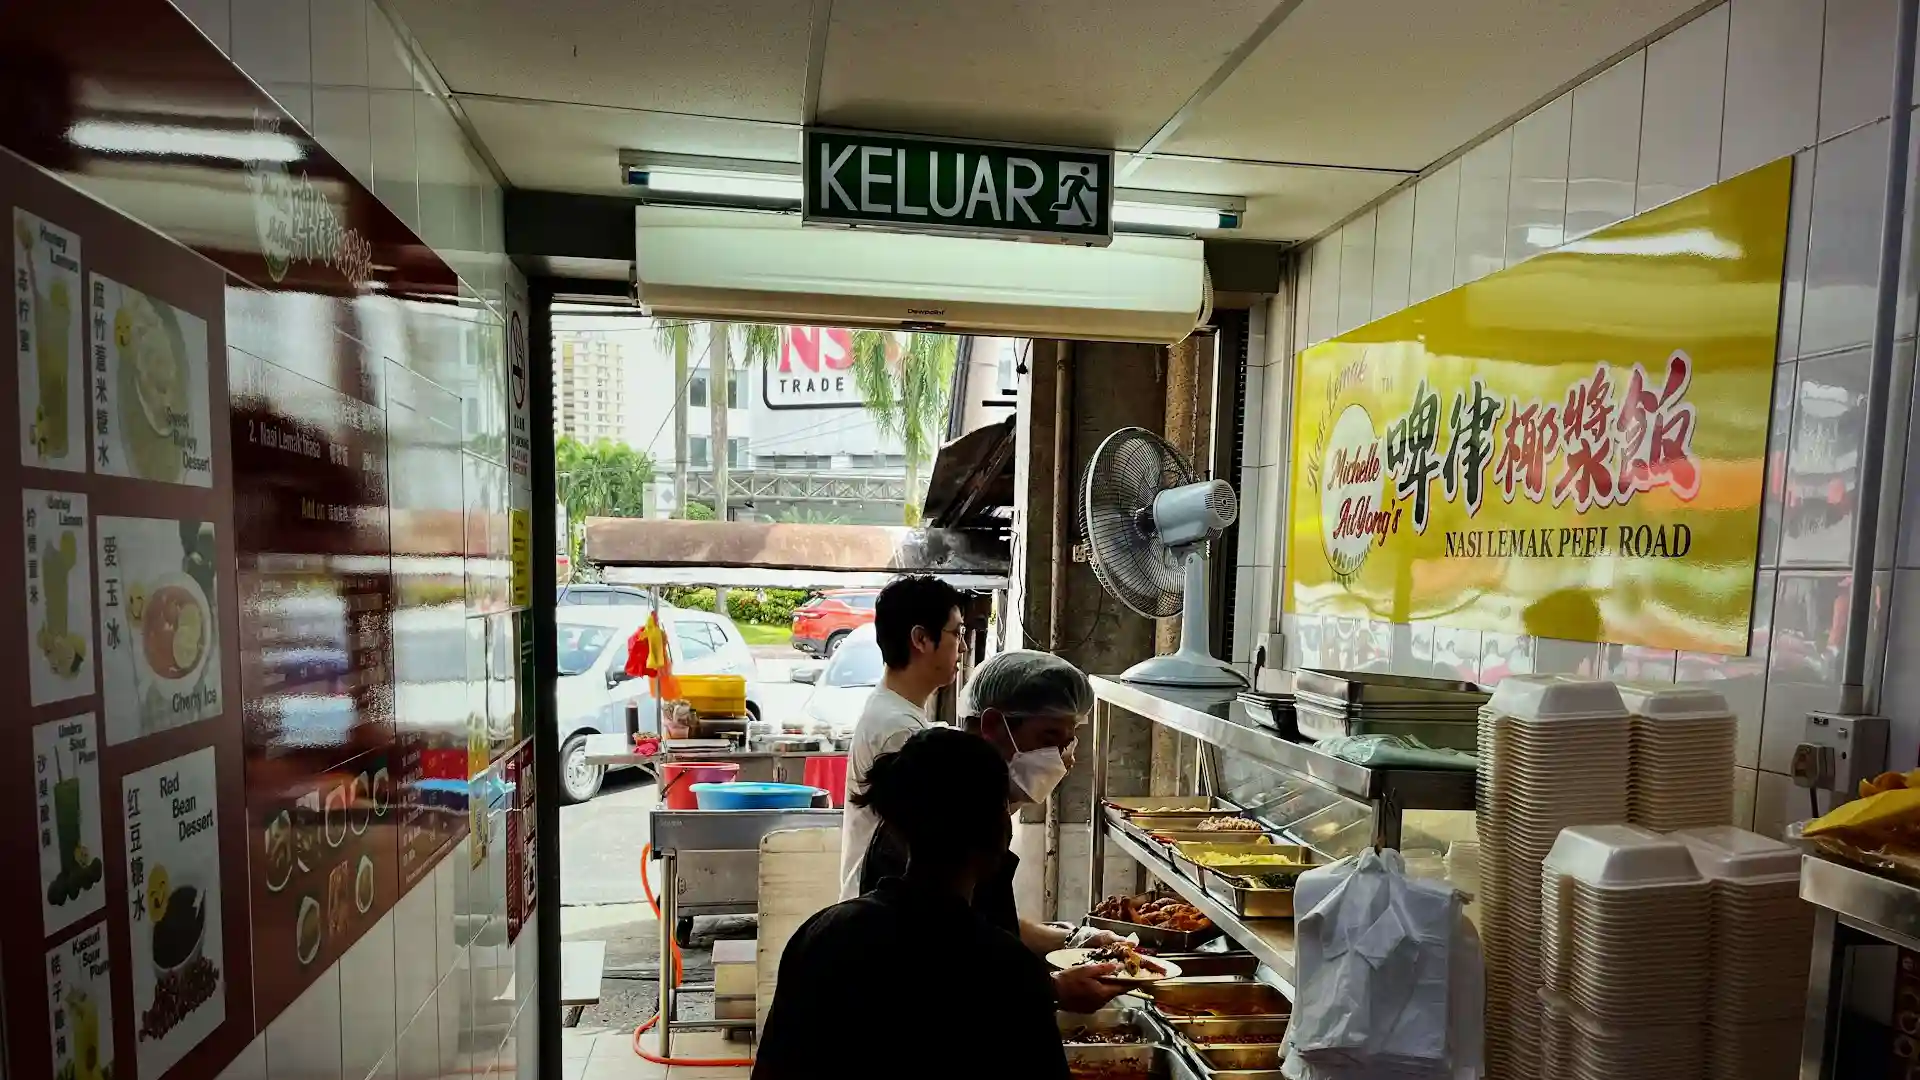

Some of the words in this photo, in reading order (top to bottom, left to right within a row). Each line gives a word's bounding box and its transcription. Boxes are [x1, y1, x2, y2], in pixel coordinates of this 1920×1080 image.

[821, 142, 1044, 224] KELUAR
[779, 376, 844, 393] TRADE
[1327, 442, 1382, 491] Michelle
[1444, 531, 1484, 558] NASI
[1486, 528, 1554, 558] LEMAK
[1556, 526, 1612, 558] PEEL
[1618, 523, 1692, 559] ROAD
[172, 690, 202, 713] Cherry
[204, 684, 217, 705] Ice
[159, 771, 180, 799] Red
[171, 793, 197, 820] Bean
[178, 808, 214, 843] Dessert
[82, 945, 101, 968] Sour
